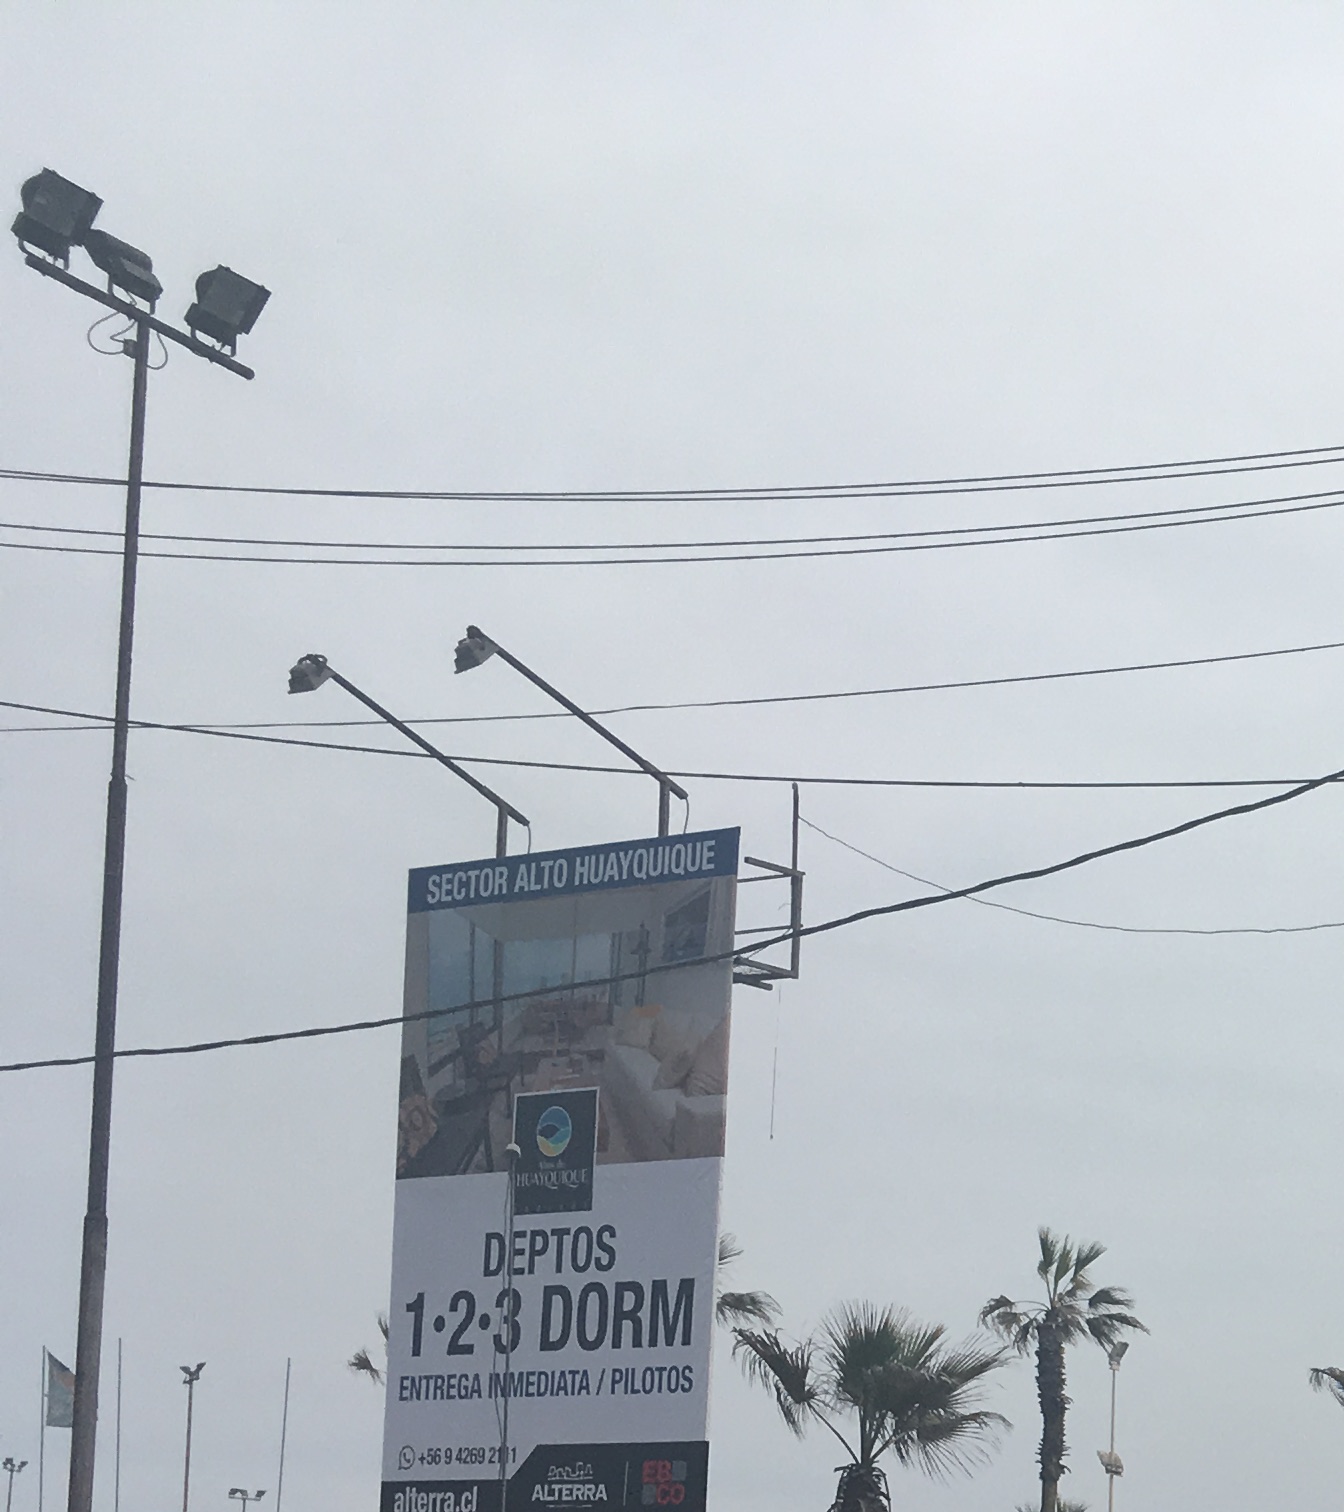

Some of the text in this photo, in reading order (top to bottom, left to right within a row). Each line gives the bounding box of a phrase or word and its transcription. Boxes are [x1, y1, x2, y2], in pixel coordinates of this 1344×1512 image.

[426, 839, 716, 905] SECTOR ALTO HUAYQUIQUE
[516, 1168, 588, 1190] HUAYQUIQUE
[483, 1224, 617, 1277] DEPTOS
[540, 1277, 696, 1352] DORM
[399, 1373, 482, 1402] ENTREGA
[488, 1369, 591, 1400] INMEDIATA
[610, 1365, 694, 1395] PILOTOS
[418, 1447, 442, 1466] +56
[444, 1447, 453, 1465] 9
[455, 1447, 485, 1465] 4269
[532, 1484, 608, 1501] ALTERRA
